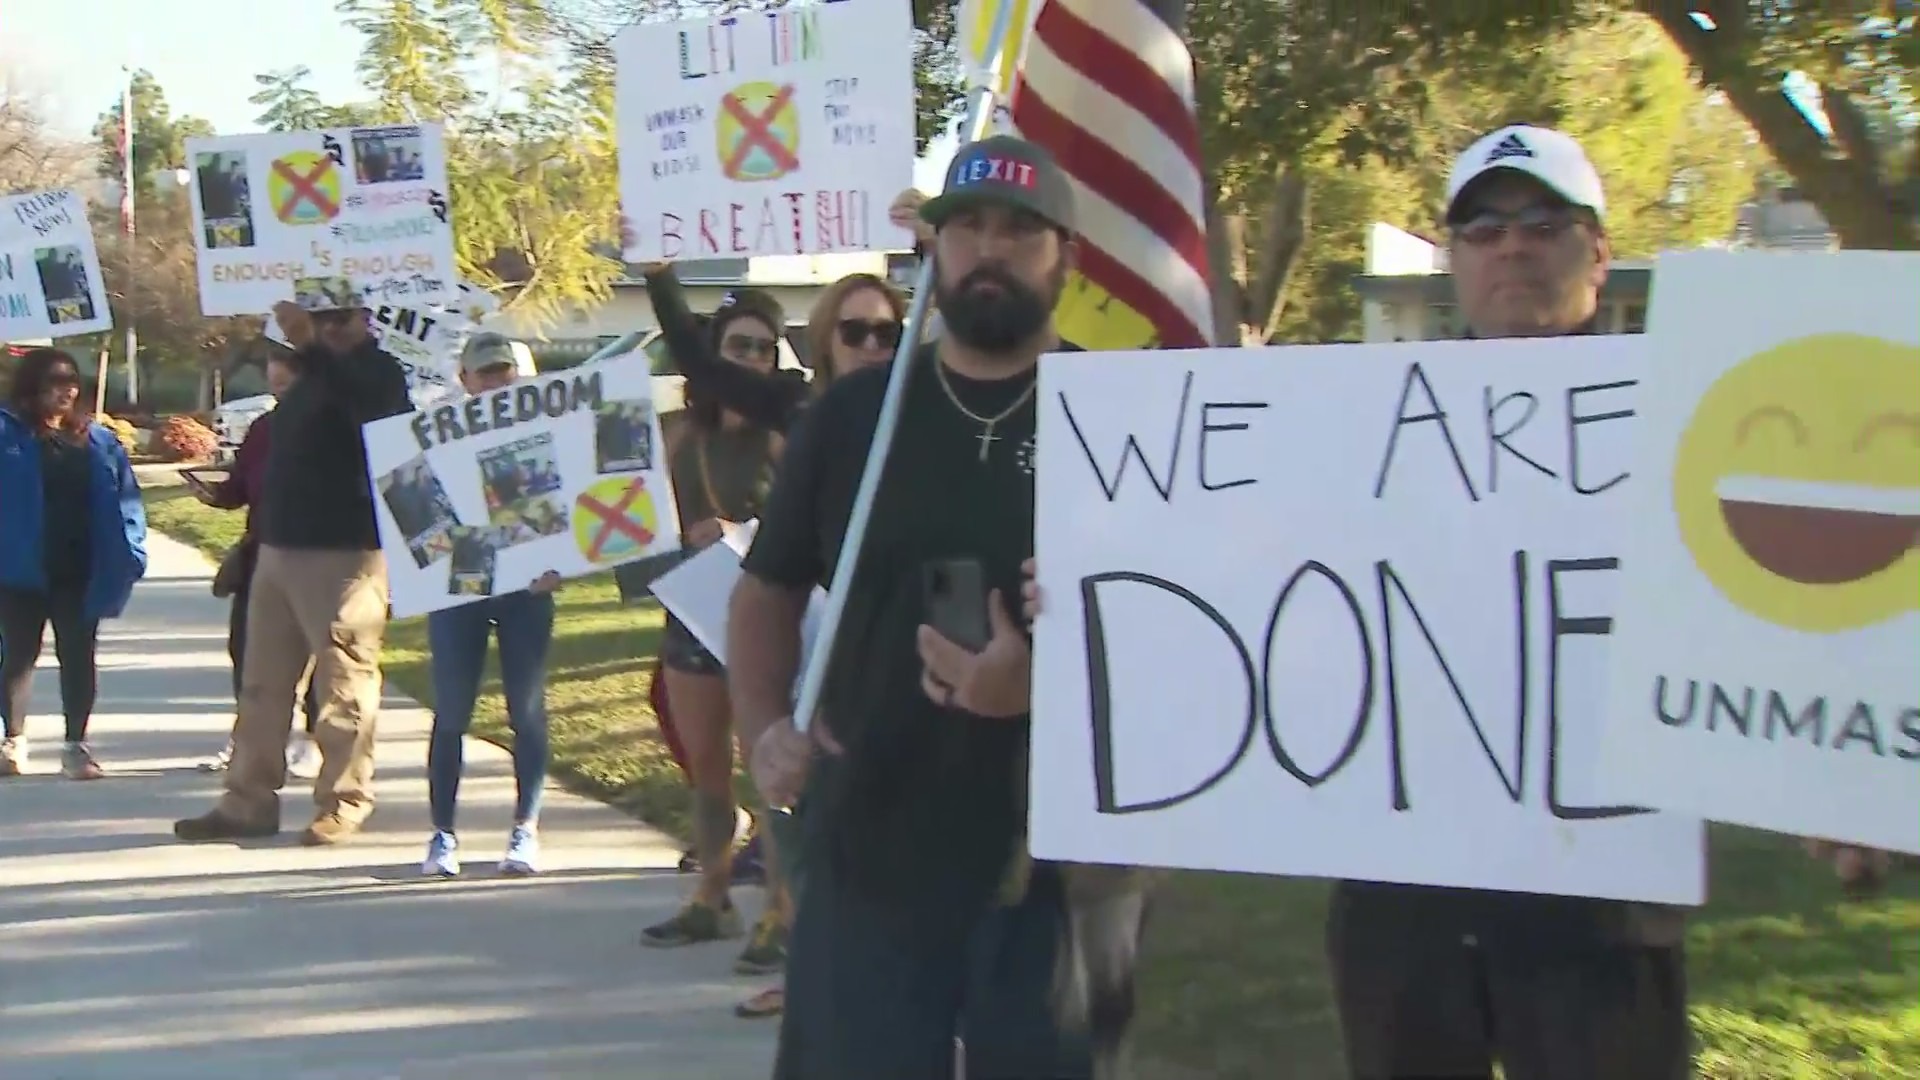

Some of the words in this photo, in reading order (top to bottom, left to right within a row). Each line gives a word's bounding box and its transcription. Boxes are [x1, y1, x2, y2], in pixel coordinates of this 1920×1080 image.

[213, 262, 304, 282] ENOUGH
[411, 371, 605, 450] FREEDOM
[1059, 370, 1268, 502] WE
[1374, 362, 1637, 501] ARE
[1081, 550, 1660, 820] DONE
